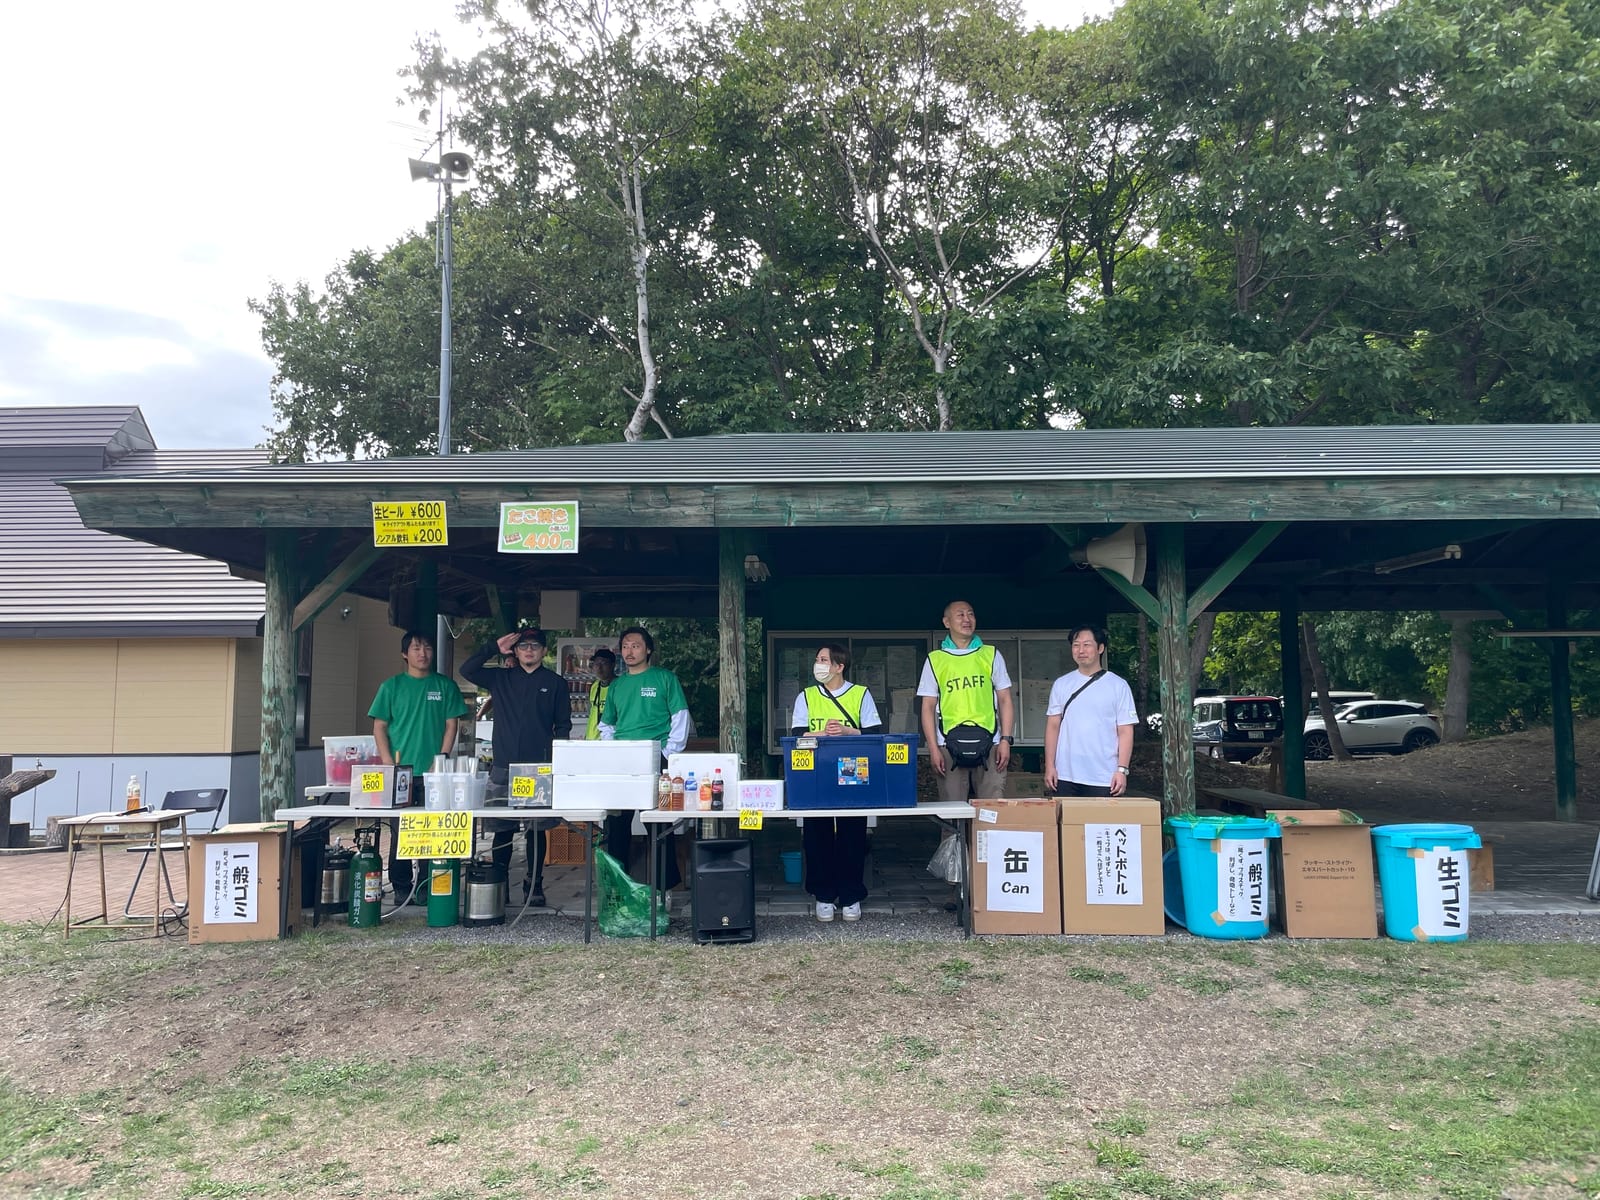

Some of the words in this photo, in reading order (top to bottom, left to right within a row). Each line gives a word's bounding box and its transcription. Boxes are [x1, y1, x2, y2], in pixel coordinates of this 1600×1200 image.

[375, 506, 404, 518] 生ビール
[411, 502, 441, 518] ¥600
[507, 508, 568, 524] たこ焼き
[414, 529, 442, 542] ¥200
[946, 675, 985, 693] STAFF
[400, 816, 431, 830] 生ビール
[438, 812, 468, 828] ¥600
[437, 840, 467, 854] ¥200
[1003, 848, 1029, 873] 缶
[1114, 828, 1128, 895] ペットボトル
[233, 854, 250, 918] 一般ゴミ
[1001, 881, 1029, 894] Can
[1248, 851, 1262, 916] 一般ゴミ
[1438, 857, 1460, 928] 生ゴミ
